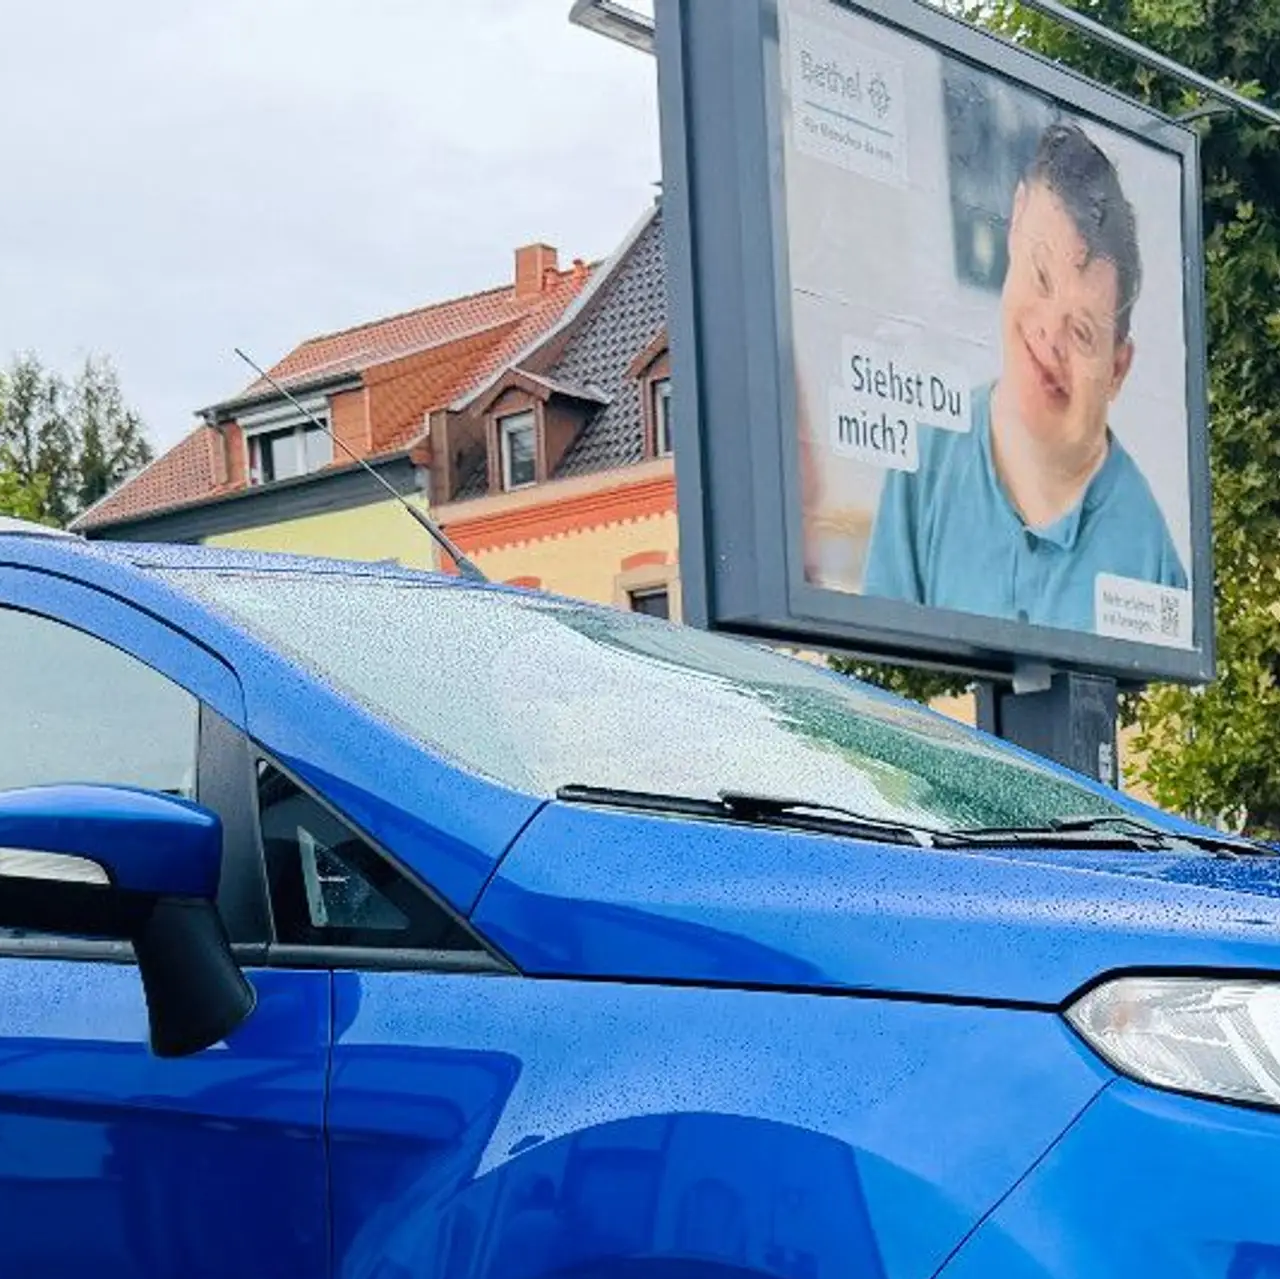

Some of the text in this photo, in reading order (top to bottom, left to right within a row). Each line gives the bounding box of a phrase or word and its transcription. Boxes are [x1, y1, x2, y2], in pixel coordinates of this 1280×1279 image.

[851, 355, 961, 416] Siehst Du
[839, 411, 908, 456] mich?
